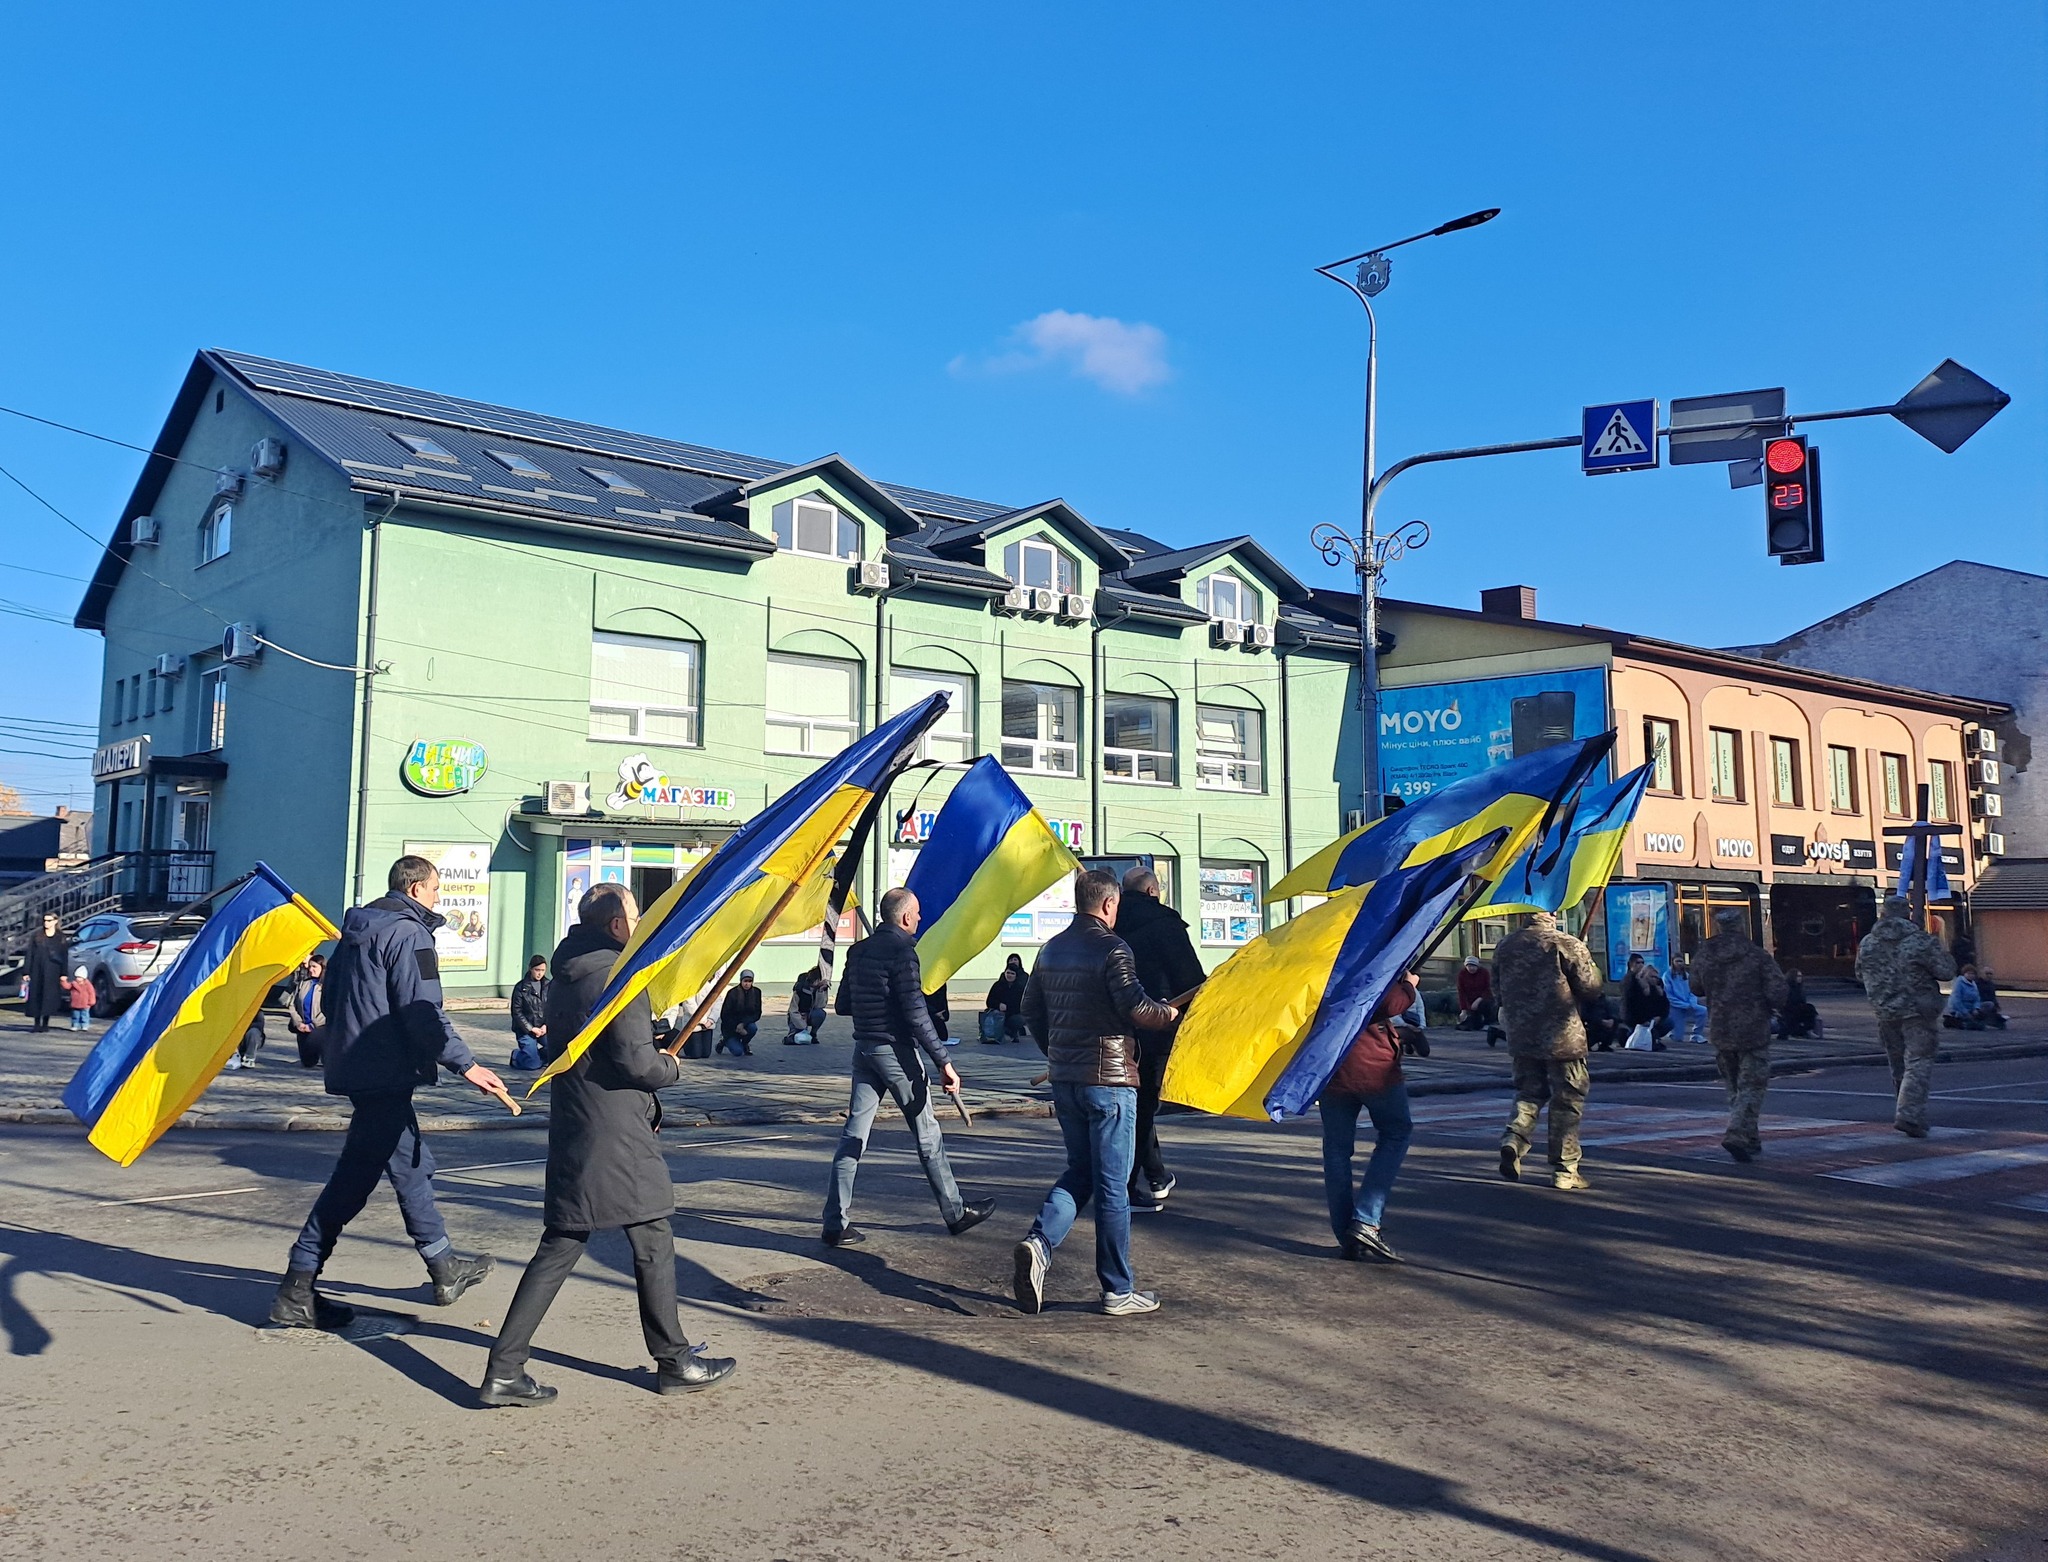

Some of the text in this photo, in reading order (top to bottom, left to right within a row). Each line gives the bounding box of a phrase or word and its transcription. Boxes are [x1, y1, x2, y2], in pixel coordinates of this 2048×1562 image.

[1773, 484, 1803, 506] 23
[1380, 709, 1462, 736] MOYO
[1381, 734, 1482, 752] Мінус ціни, плюс вайб
[91, 741, 140, 777] ШПАЛЕРИ
[410, 742, 485, 768] ДИТЯЧИЙ
[444, 765, 478, 790] СВІТ
[642, 787, 728, 807] МАГАЗИН
[1391, 782, 1401, 795] 4
[1049, 821, 1083, 846] ВІТ
[1644, 832, 1685, 853] MOYO
[1717, 838, 1755, 858] MOYO
[1809, 841, 1842, 860] JOYS
[438, 867, 481, 880] FAMILY
[443, 884, 476, 895] центр
